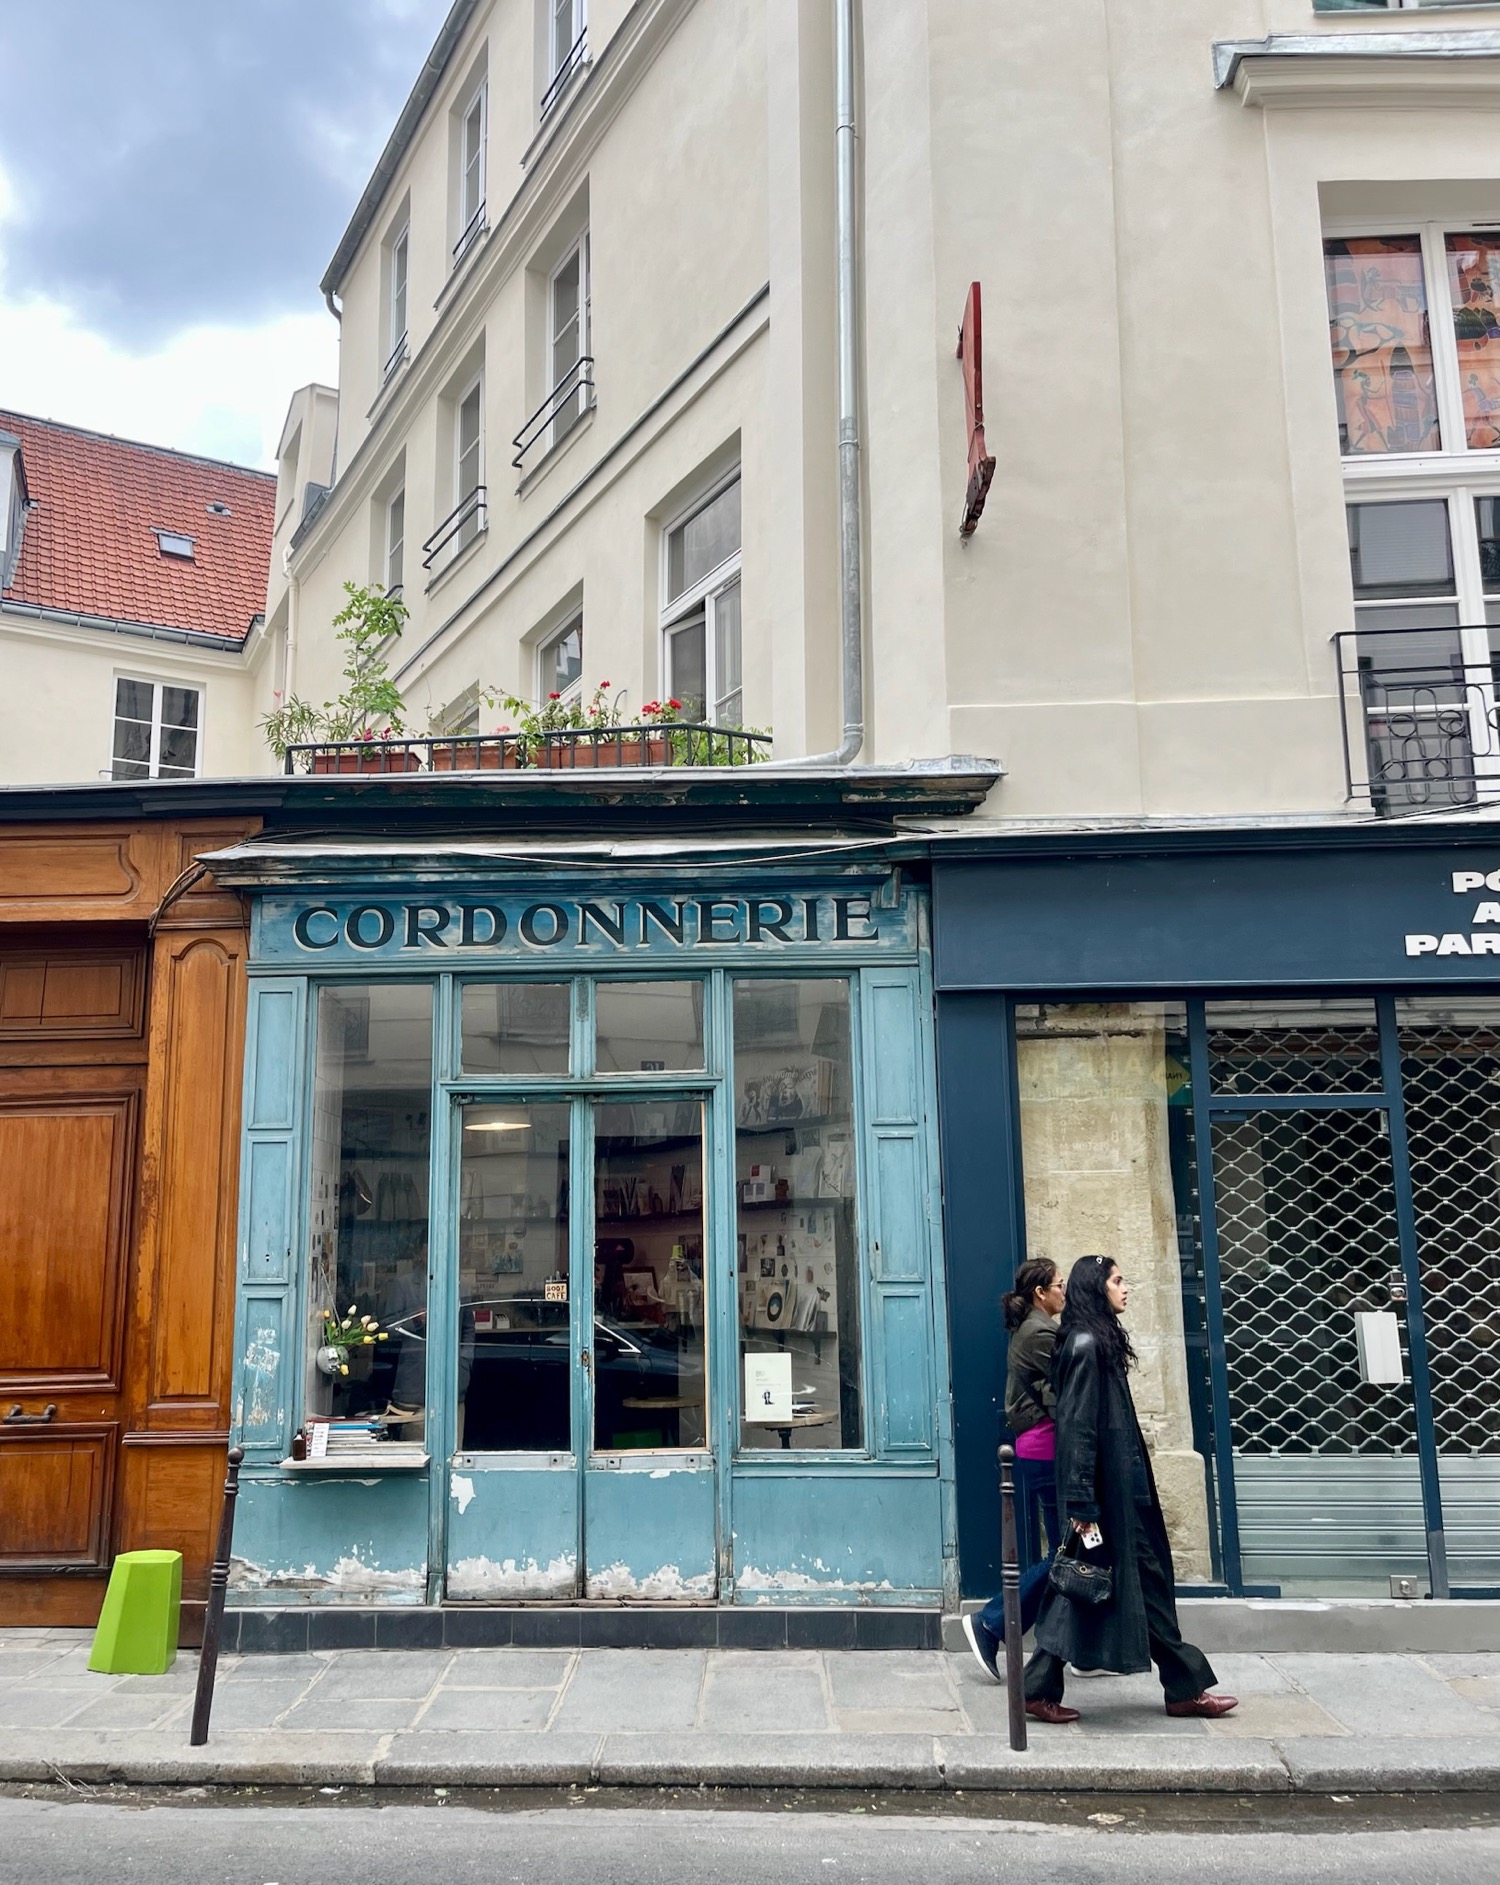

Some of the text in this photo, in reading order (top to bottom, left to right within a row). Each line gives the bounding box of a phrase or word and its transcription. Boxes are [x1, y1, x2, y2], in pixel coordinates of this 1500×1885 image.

[294, 898, 878, 949] CORDONNERIE
[1472, 902, 1500, 923] A
[1405, 933, 1500, 956] PAR
